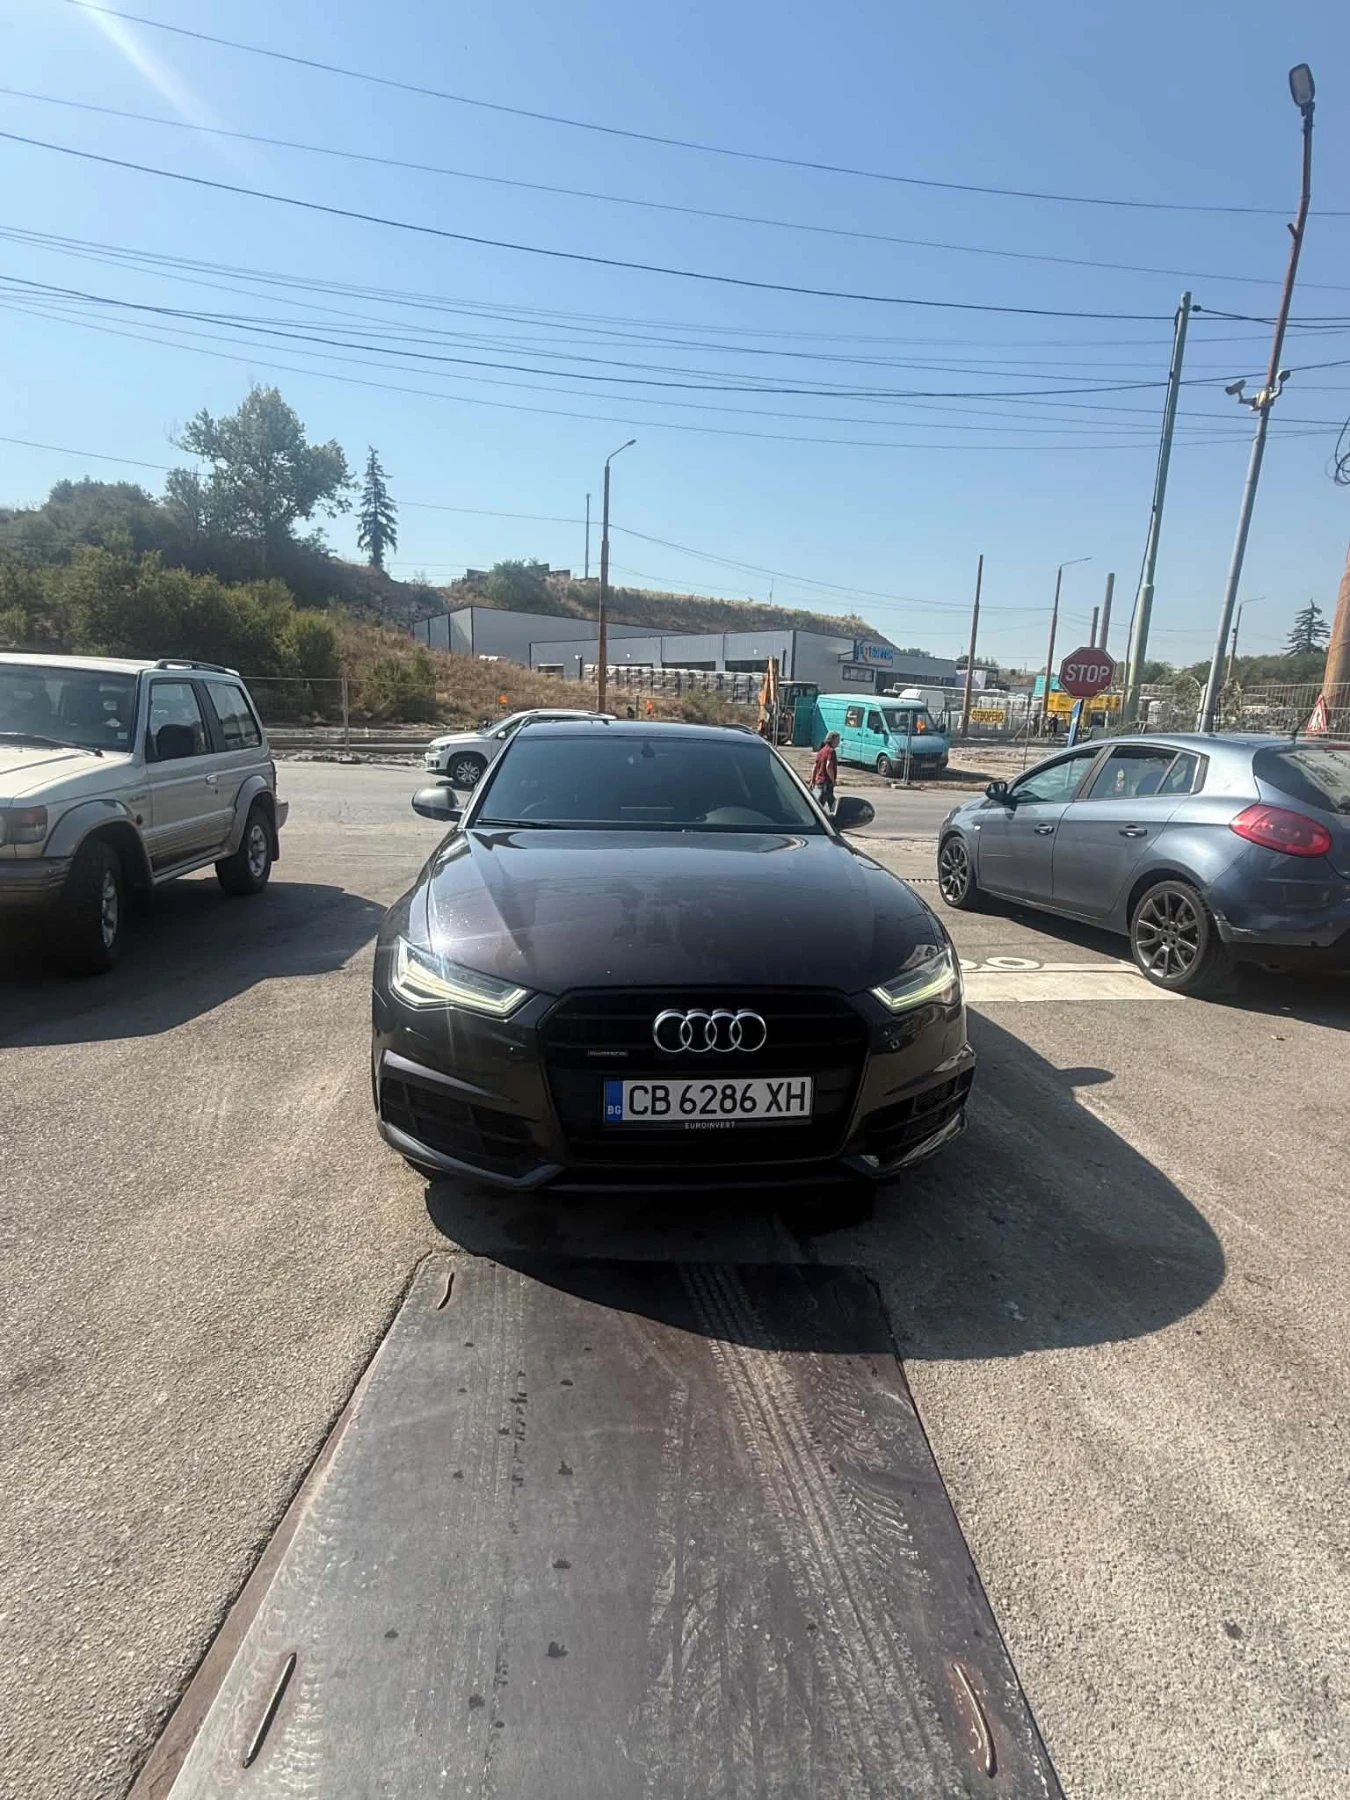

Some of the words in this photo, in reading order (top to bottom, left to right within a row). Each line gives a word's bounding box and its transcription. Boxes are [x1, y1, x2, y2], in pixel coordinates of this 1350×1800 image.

[1065, 663, 1110, 683] STOP
[628, 1084, 671, 1116] CB
[679, 1083, 758, 1115] 6286
[764, 1081, 806, 1113] XH
[607, 1105, 621, 1115] BG
[684, 1121, 736, 1130] EUROINVEST
